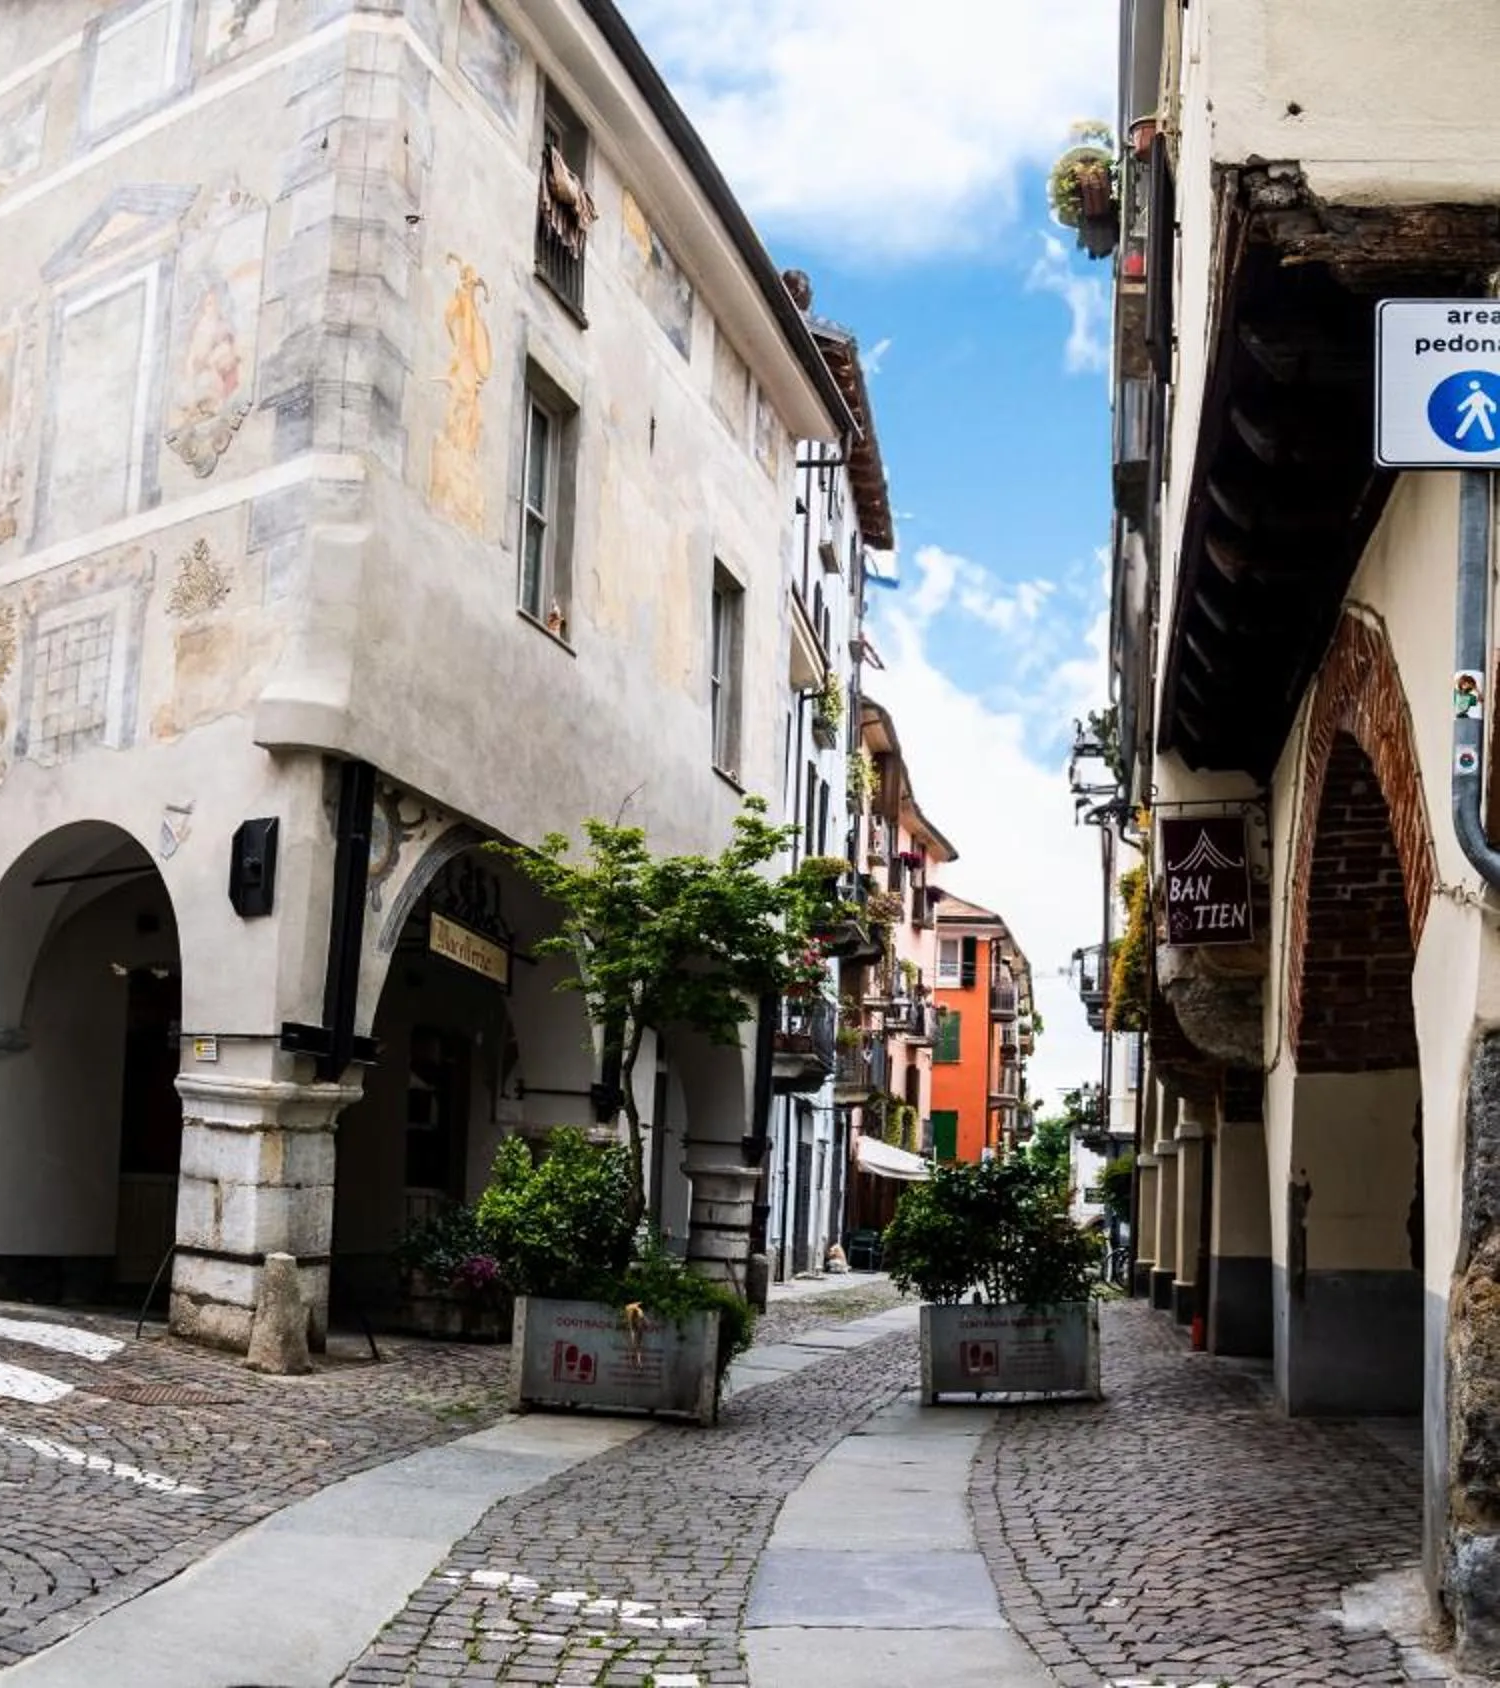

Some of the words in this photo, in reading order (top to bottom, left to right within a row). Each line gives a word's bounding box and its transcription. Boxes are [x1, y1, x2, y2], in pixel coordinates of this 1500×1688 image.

[1447, 309, 1500, 324] area
[1415, 333, 1500, 355] pedon
[1170, 874, 1212, 902] BAN
[1193, 902, 1247, 930] TIEN
